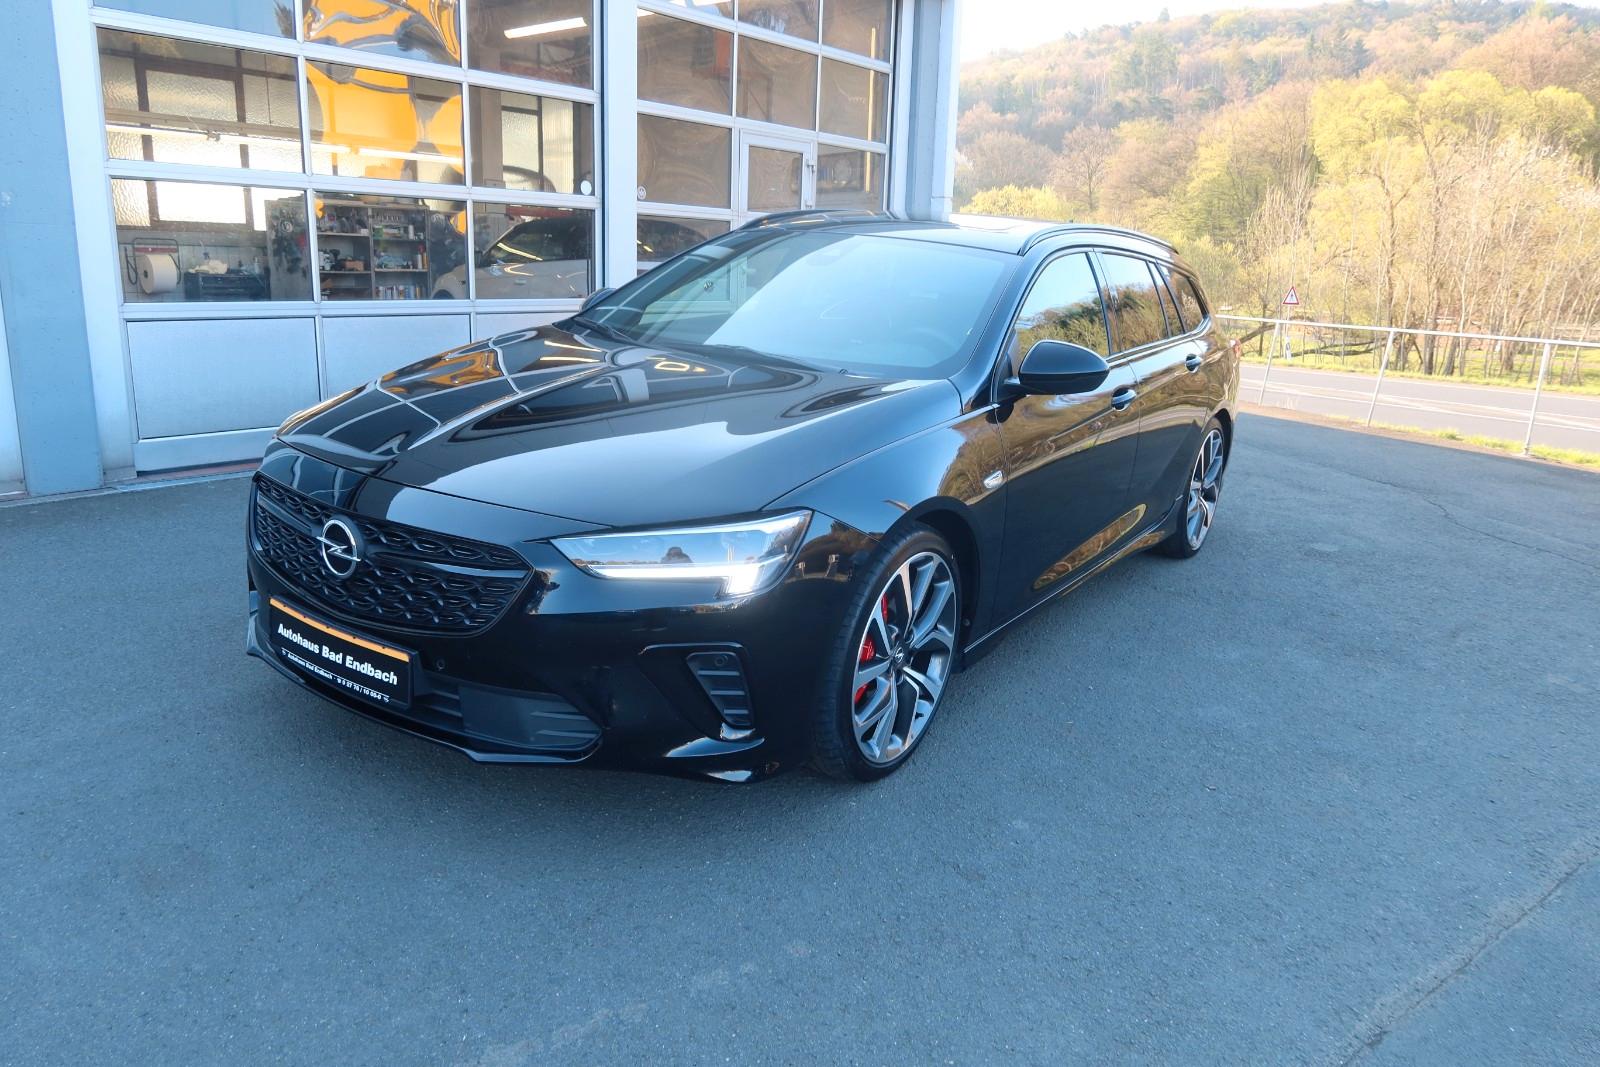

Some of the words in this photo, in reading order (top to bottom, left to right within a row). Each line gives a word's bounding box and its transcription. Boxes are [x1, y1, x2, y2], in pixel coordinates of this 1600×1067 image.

[278, 623, 319, 654] Autohaus
[321, 645, 343, 664] Bad
[345, 657, 398, 686] Endbach
